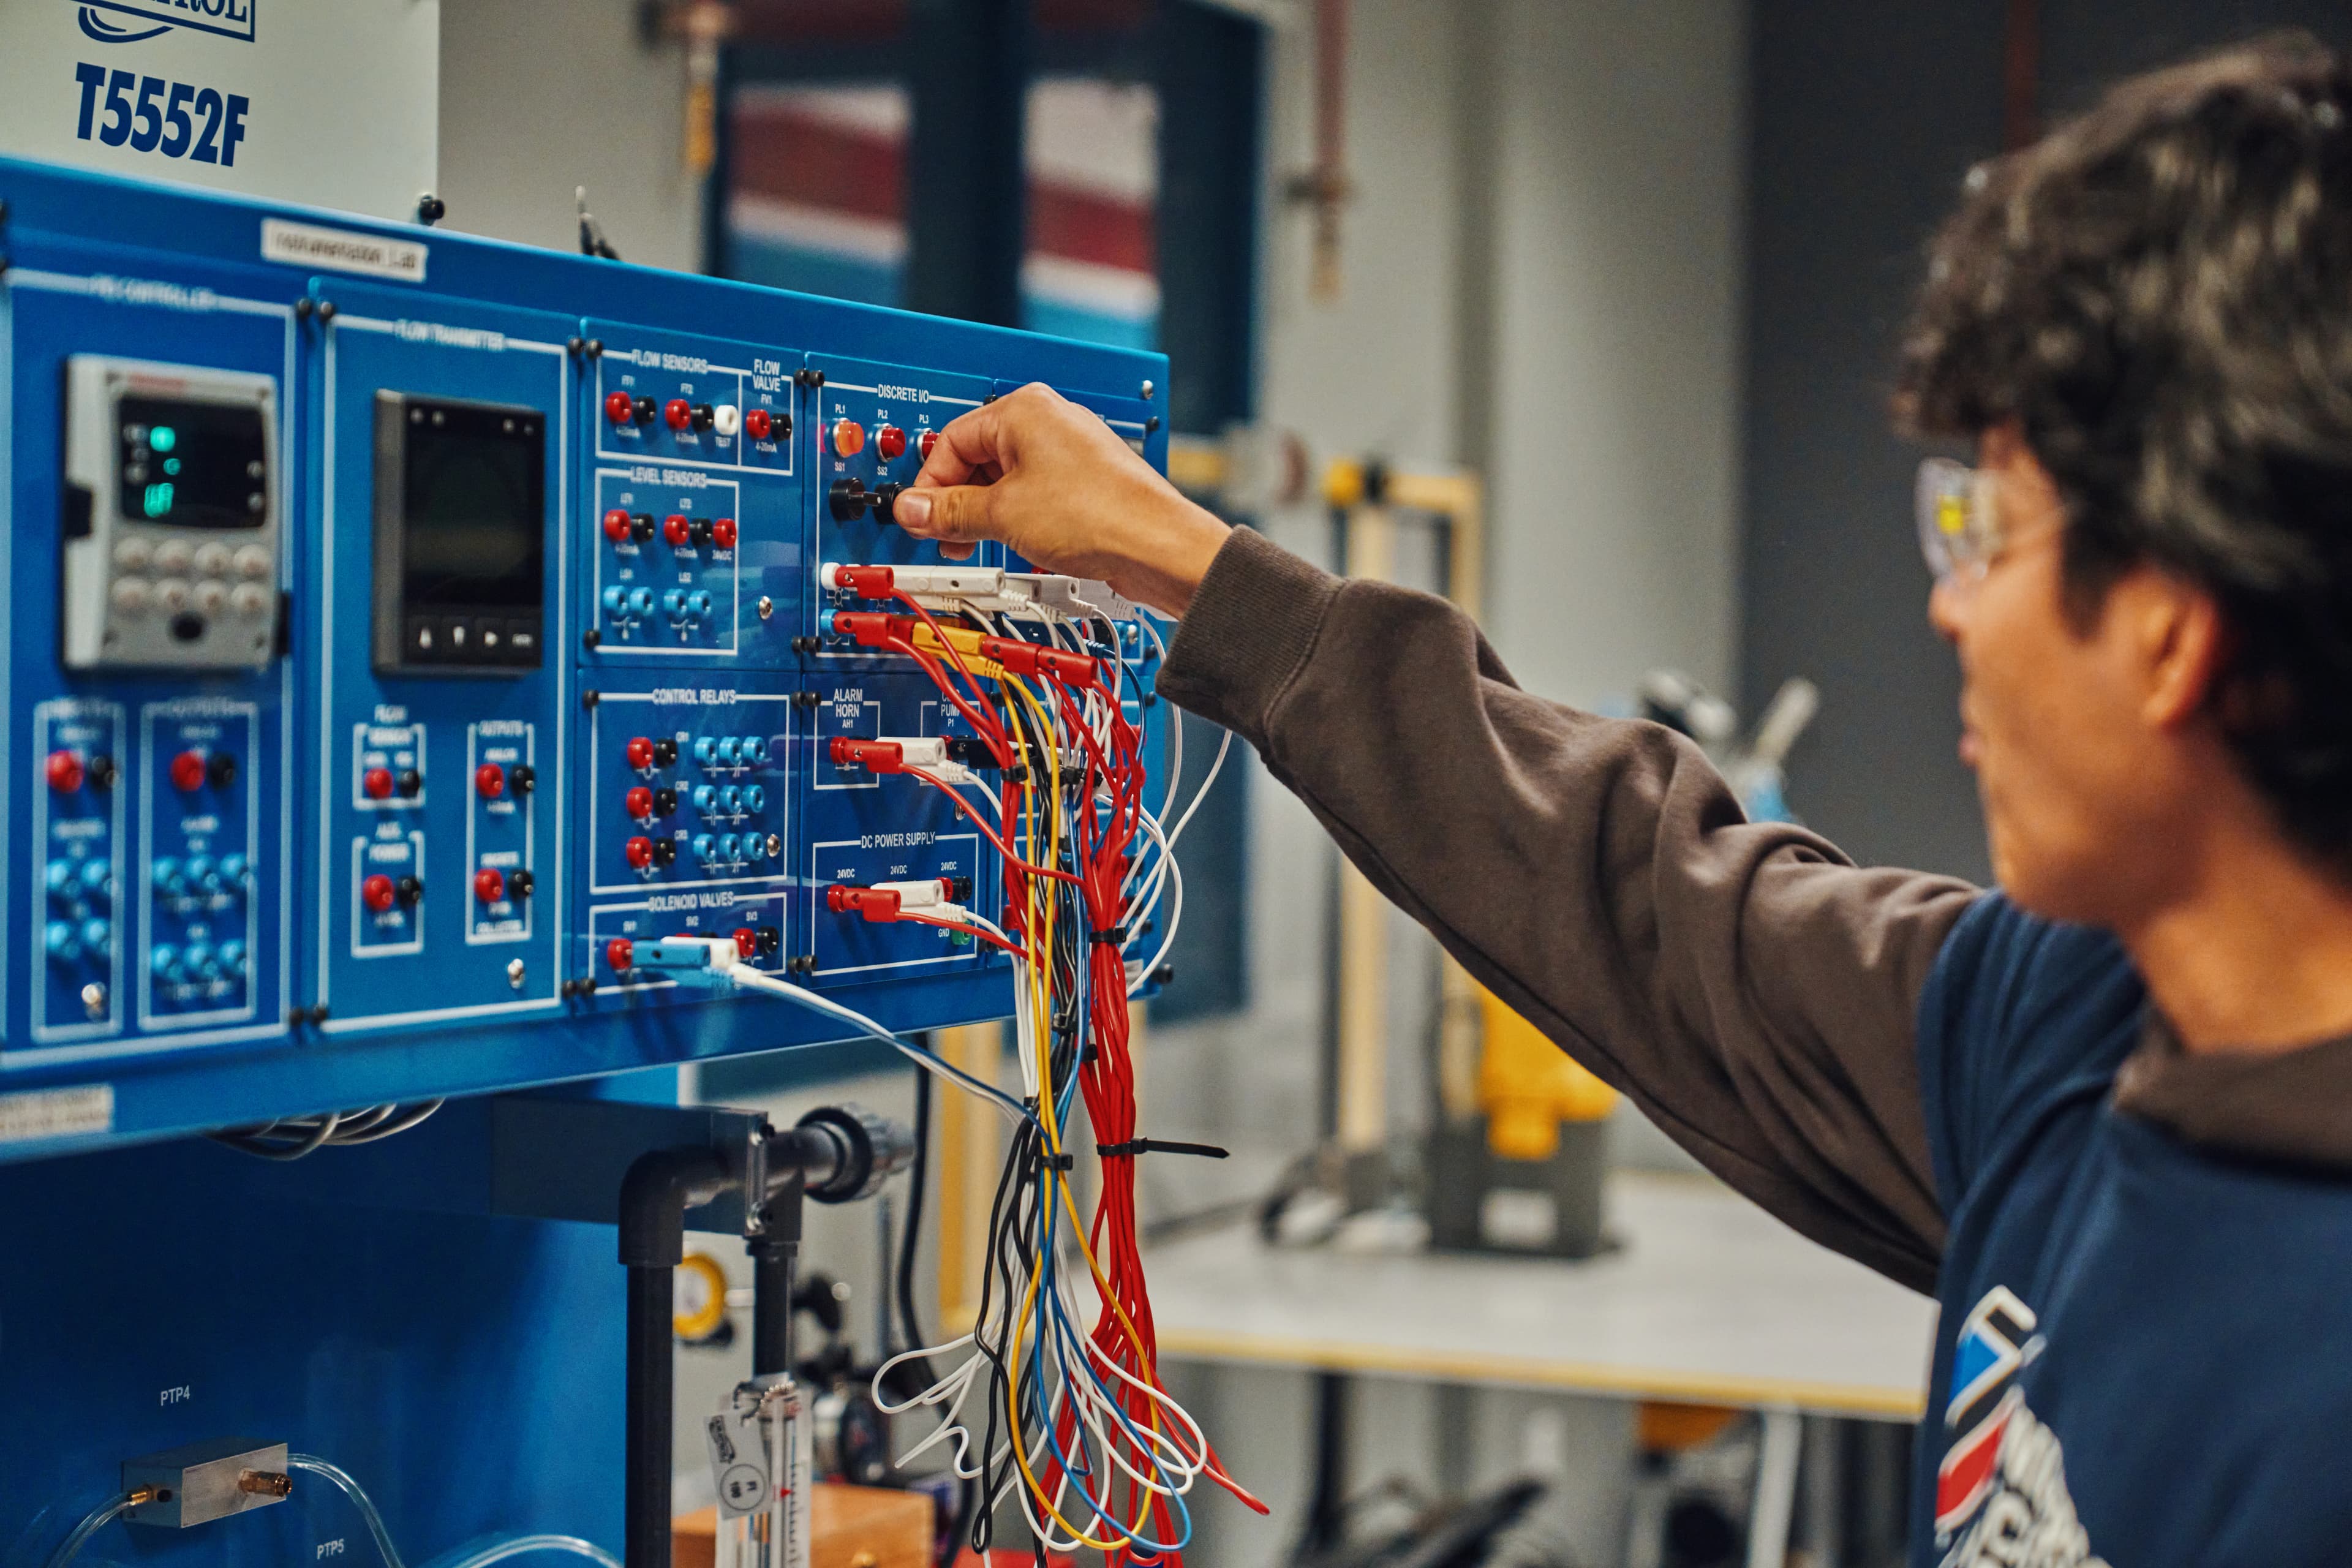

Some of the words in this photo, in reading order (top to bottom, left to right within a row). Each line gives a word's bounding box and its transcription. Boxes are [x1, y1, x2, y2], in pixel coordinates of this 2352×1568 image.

[75, 61, 249, 167] T5552F
[631, 349, 660, 368] FLOW
[662, 353, 708, 374] SENSORS
[753, 359, 780, 375] FLOW
[753, 375, 780, 392] VALVE
[878, 384, 917, 402] DISCRETE
[918, 391, 929, 403] I/O
[835, 404, 846, 414] PL1
[878, 409, 888, 419] PL2
[919, 414, 929, 424] PL3
[715, 436, 731, 448] TEST
[755, 441, 777, 453] 4-20mA
[834, 461, 845, 472] SS1
[877, 466, 888, 476] SS2
[630, 466, 660, 484] LEVEL
[662, 469, 707, 488] SENSORS
[652, 688, 698, 704] CONTROL
[700, 689, 736, 704] RELAYS
[834, 688, 862, 702] ALARM
[835, 704, 859, 718] HORN
[842, 719, 853, 728] AH1
[948, 718, 954, 727] P1
[861, 835, 873, 848] DC
[875, 833, 904, 848] POWER
[906, 831, 935, 846] SUPPLY
[890, 865, 907, 875] 24VDC
[940, 861, 957, 871] 24VDC
[837, 869, 855, 878] 24VDC
[647, 894, 698, 912] SOLENOID
[699, 891, 734, 908] VALVES
[685, 916, 699, 927] SV2
[745, 911, 758, 921] SV3
[938, 928, 949, 937] GND
[160, 1385, 190, 1406] PTP4
[317, 1538, 345, 1559] PTP5
